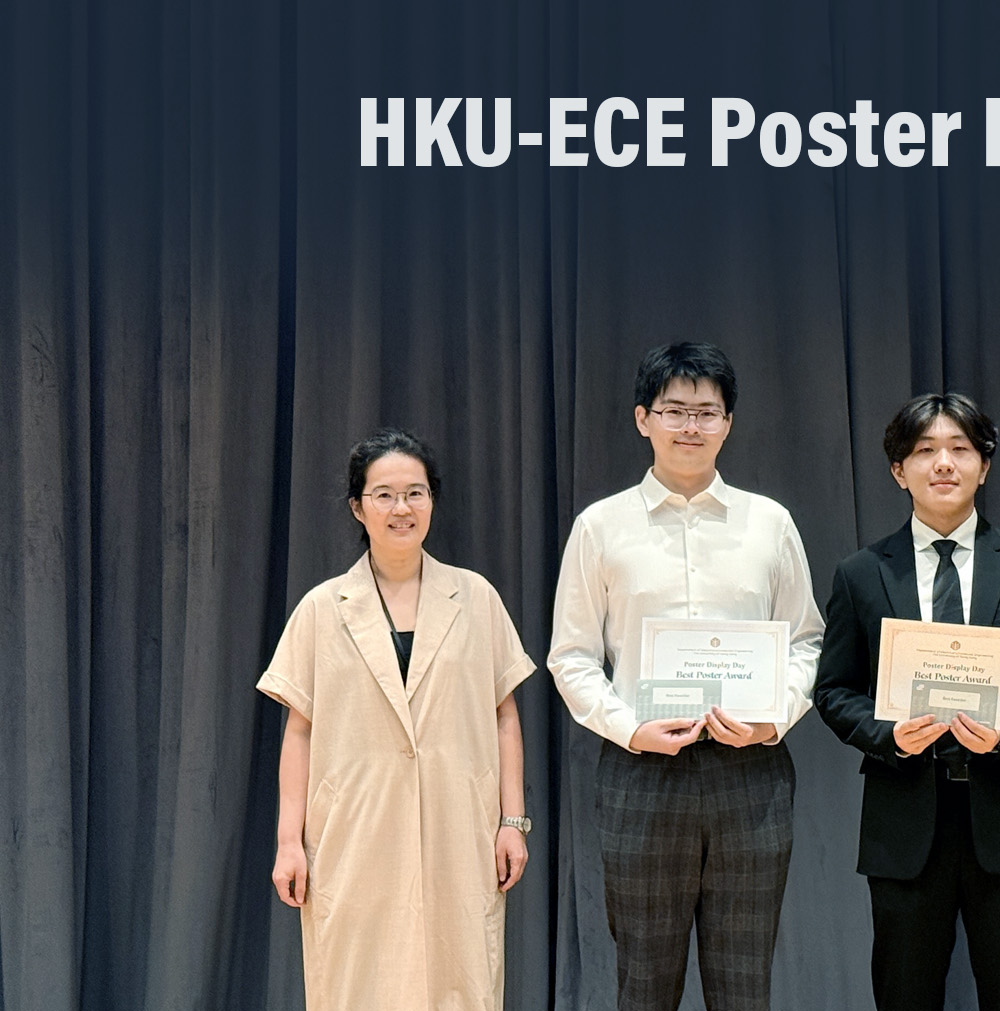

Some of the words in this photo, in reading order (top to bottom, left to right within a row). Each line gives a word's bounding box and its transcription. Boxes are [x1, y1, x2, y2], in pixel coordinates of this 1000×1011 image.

[946, 664, 970, 672] Display
[724, 671, 753, 679] Award
[935, 673, 961, 681] Poster
[962, 675, 992, 684] Award
